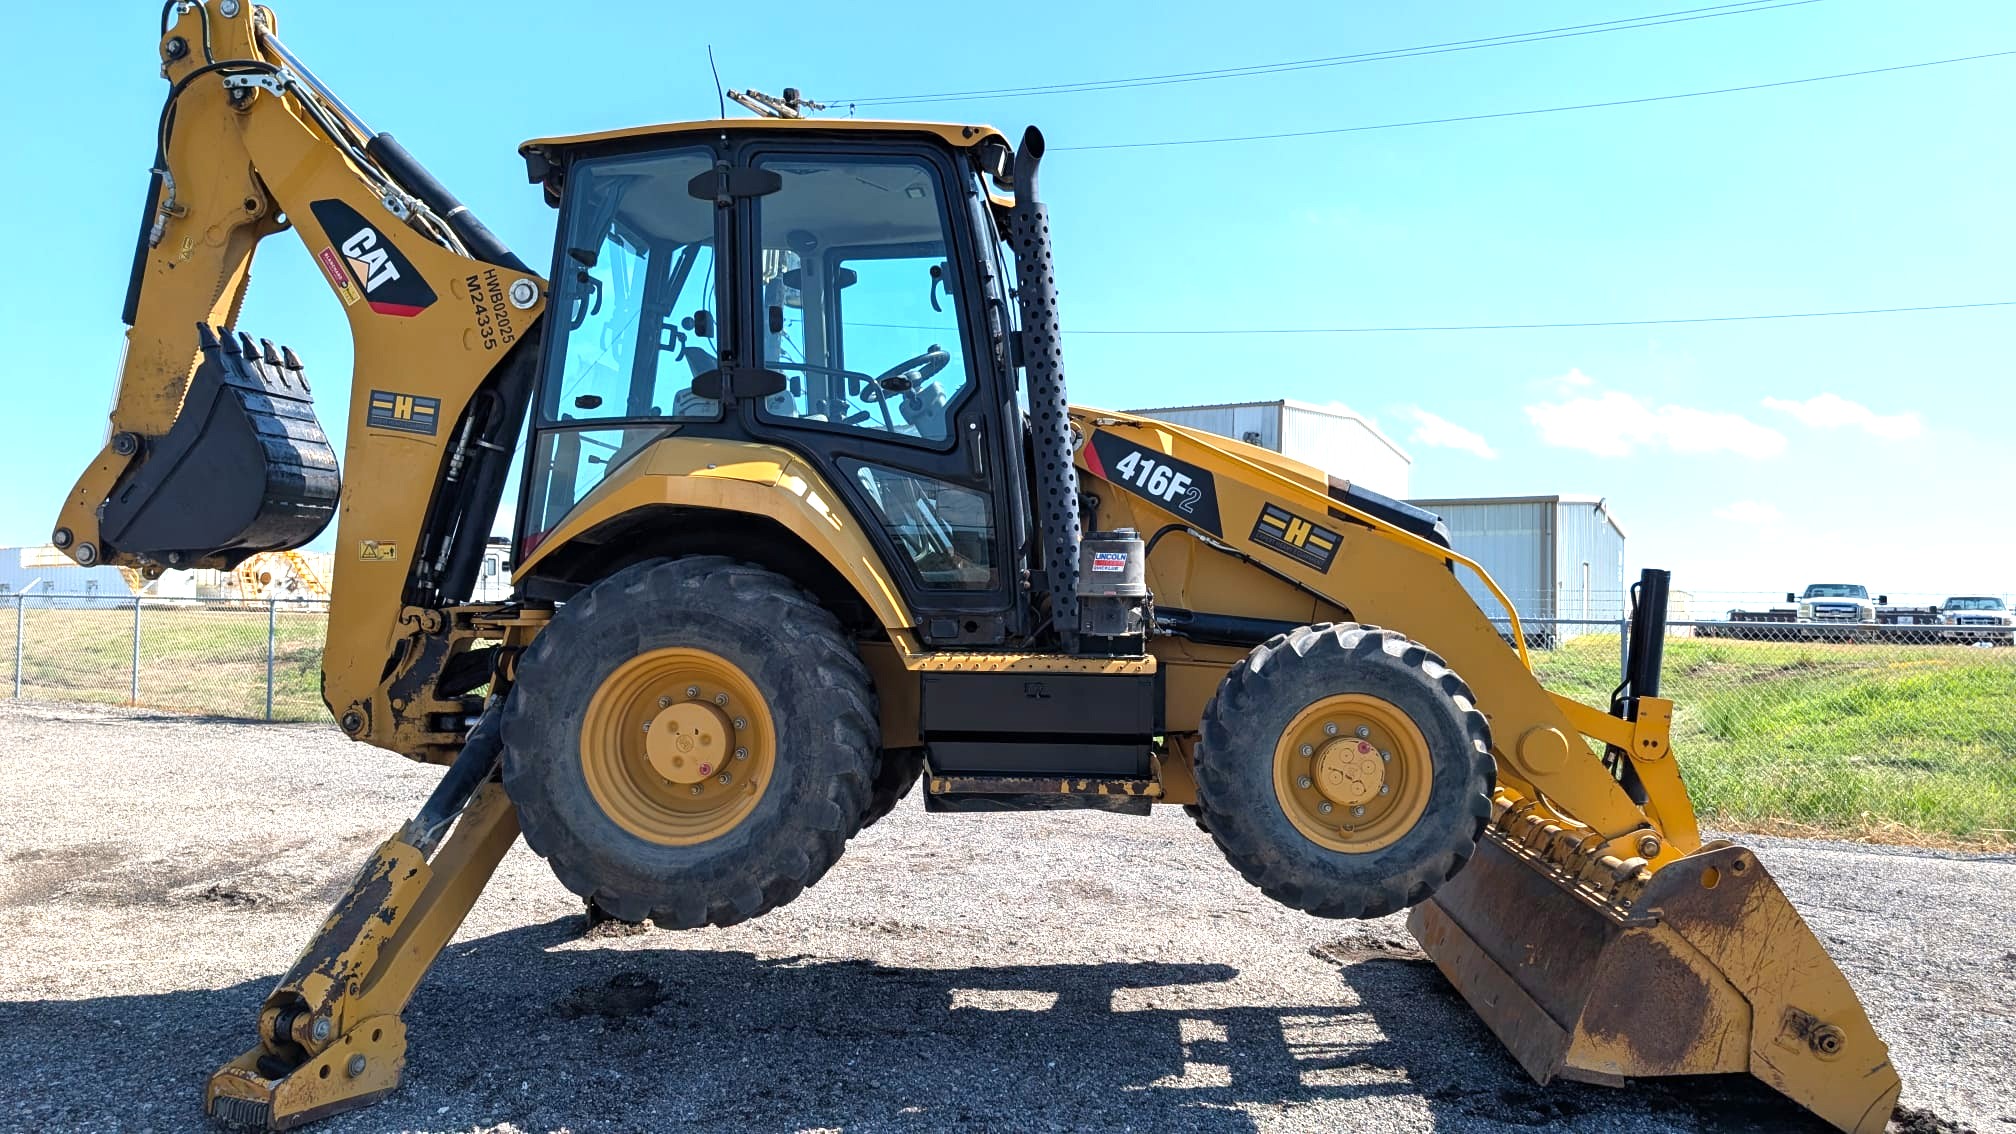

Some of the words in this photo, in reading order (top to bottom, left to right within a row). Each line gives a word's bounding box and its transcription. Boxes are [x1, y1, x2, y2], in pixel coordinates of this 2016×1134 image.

[341, 227, 400, 294] CAT
[465, 275, 497, 351] M24335
[483, 268, 515, 344] HWB02025
[394, 395, 413, 420] H
[1283, 517, 1312, 548] H
